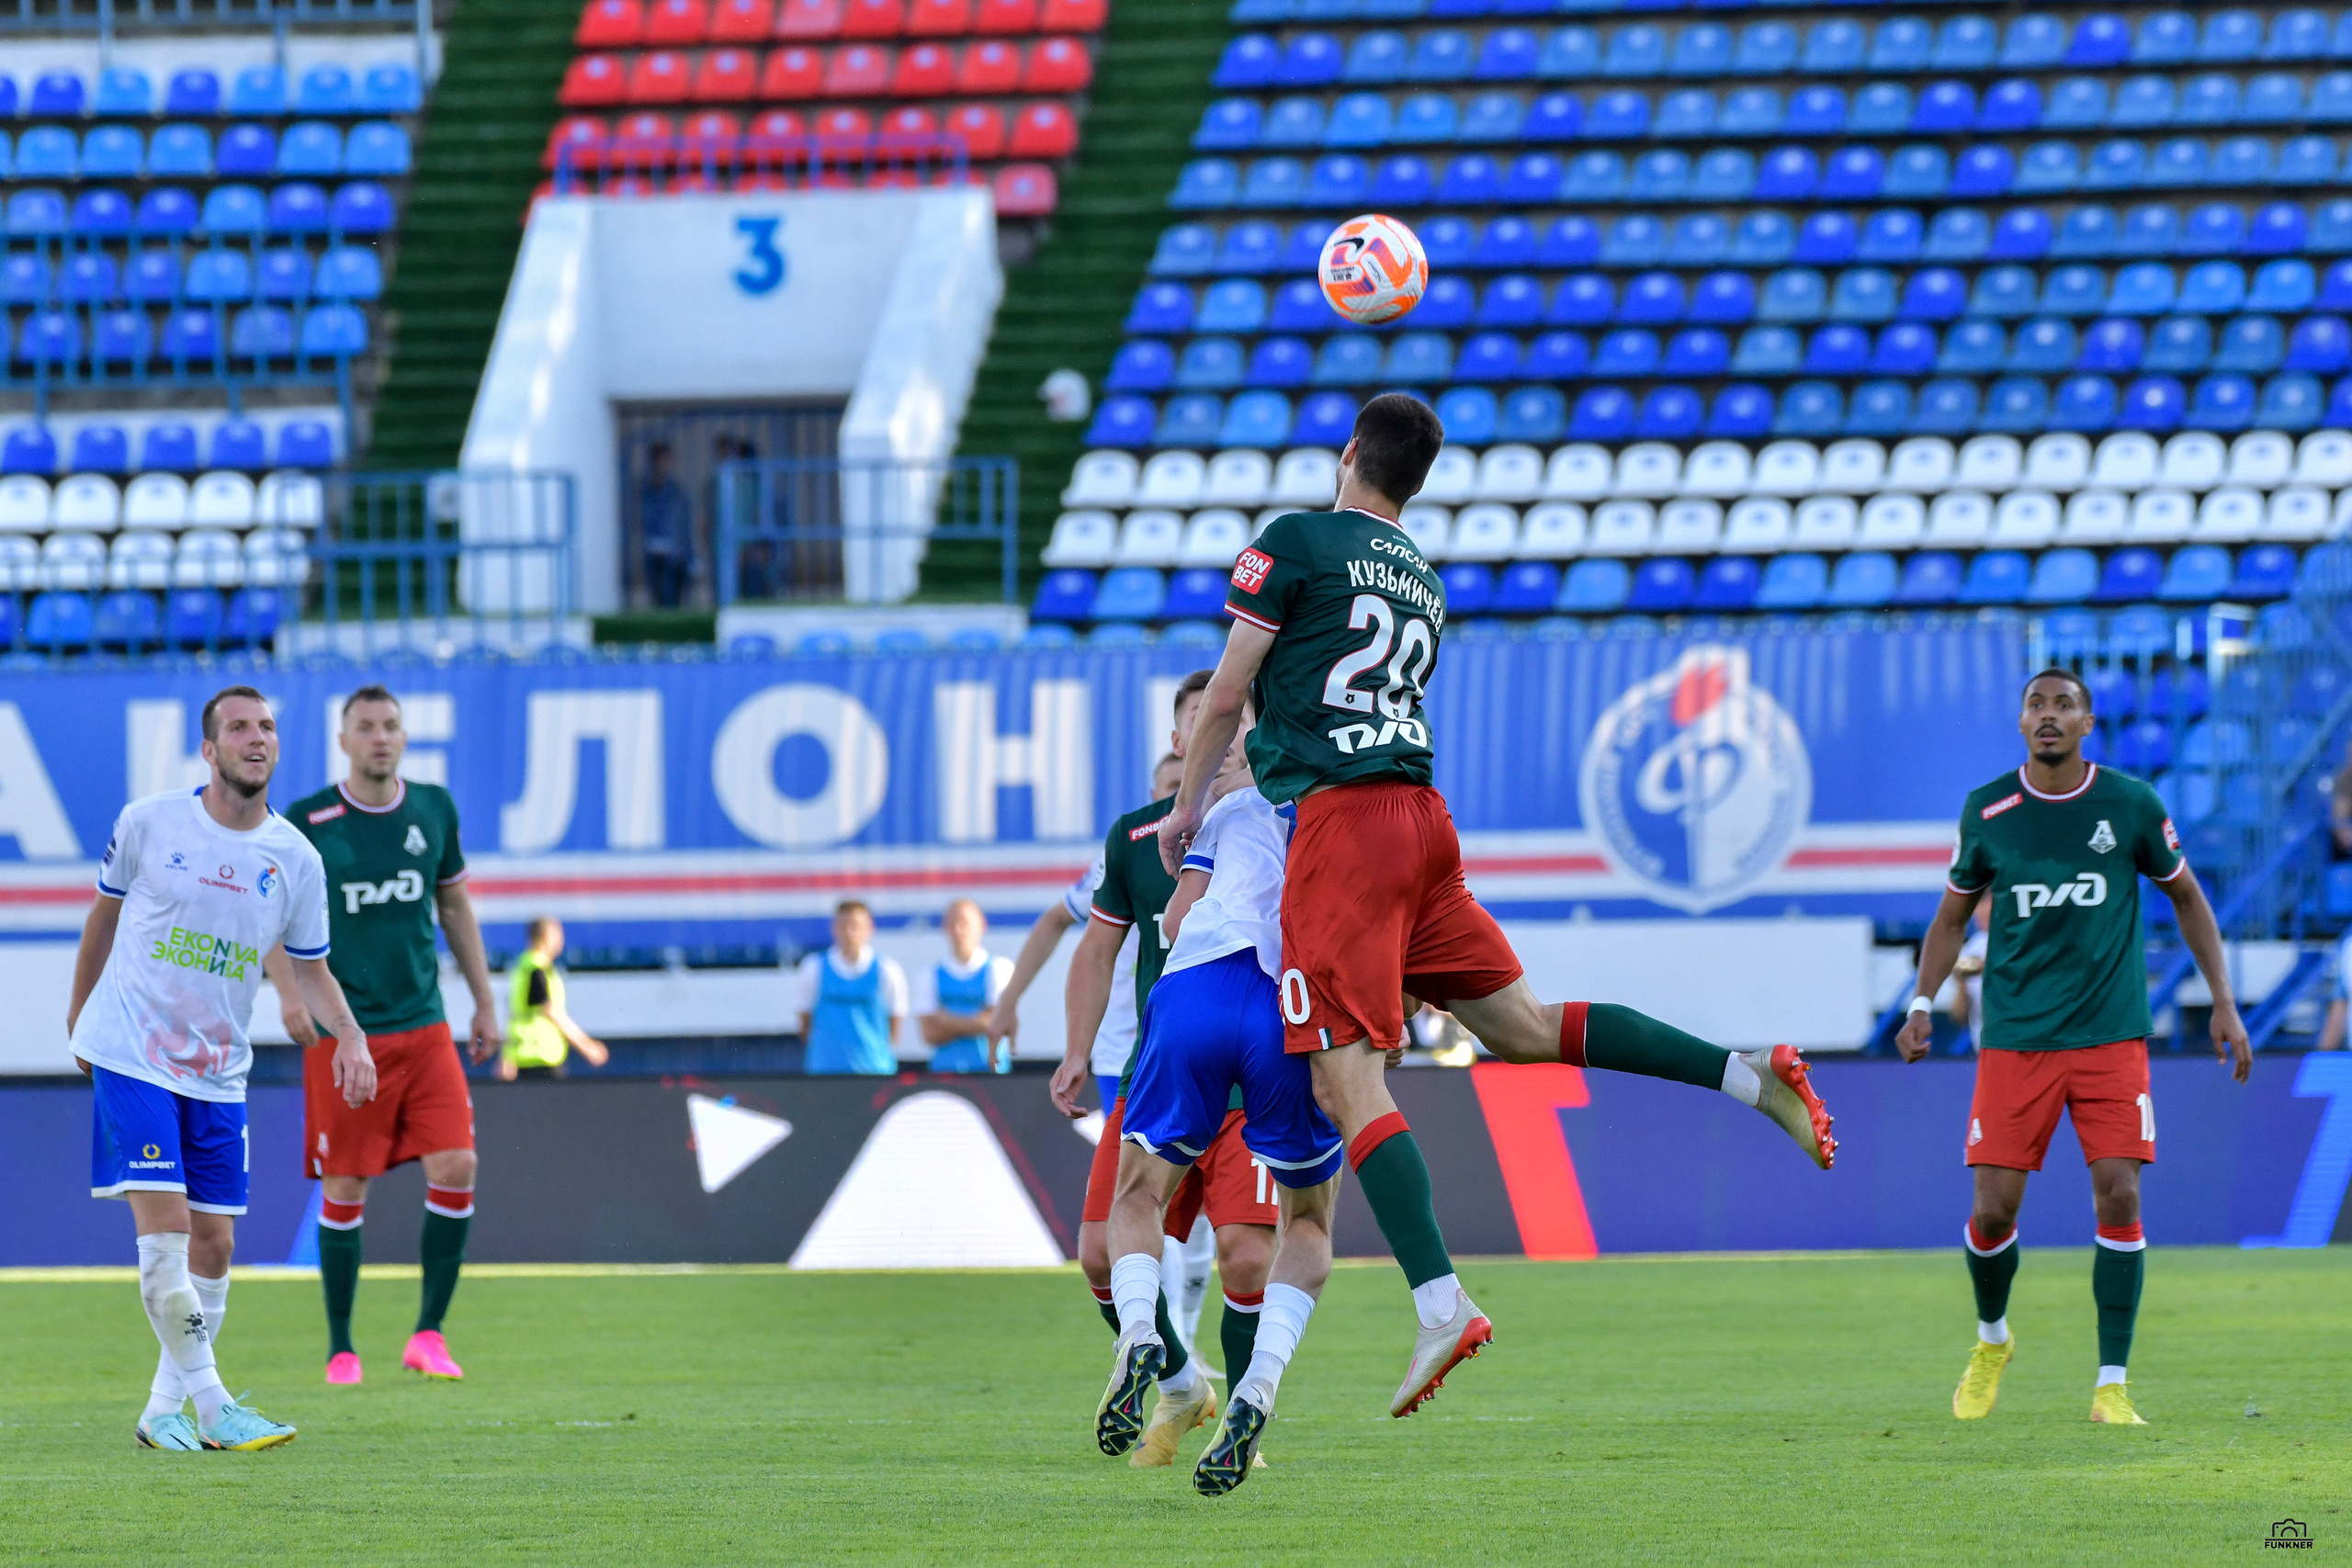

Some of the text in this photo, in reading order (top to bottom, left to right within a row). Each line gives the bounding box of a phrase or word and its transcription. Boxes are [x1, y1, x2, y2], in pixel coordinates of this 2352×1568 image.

[734, 216, 786, 294] 3
[1233, 568, 1262, 587] BET
[1238, 551, 1270, 574] FON
[1322, 593, 1431, 720] 20
[1132, 816, 1170, 840] FONBE
[198, 877, 248, 895] OLIMPBET
[151, 941, 244, 983] ЭКОНИВА
[170, 926, 258, 966] EKONIVA
[1279, 968, 1310, 1026] 0
[1250, 1157, 1278, 1206] 1
